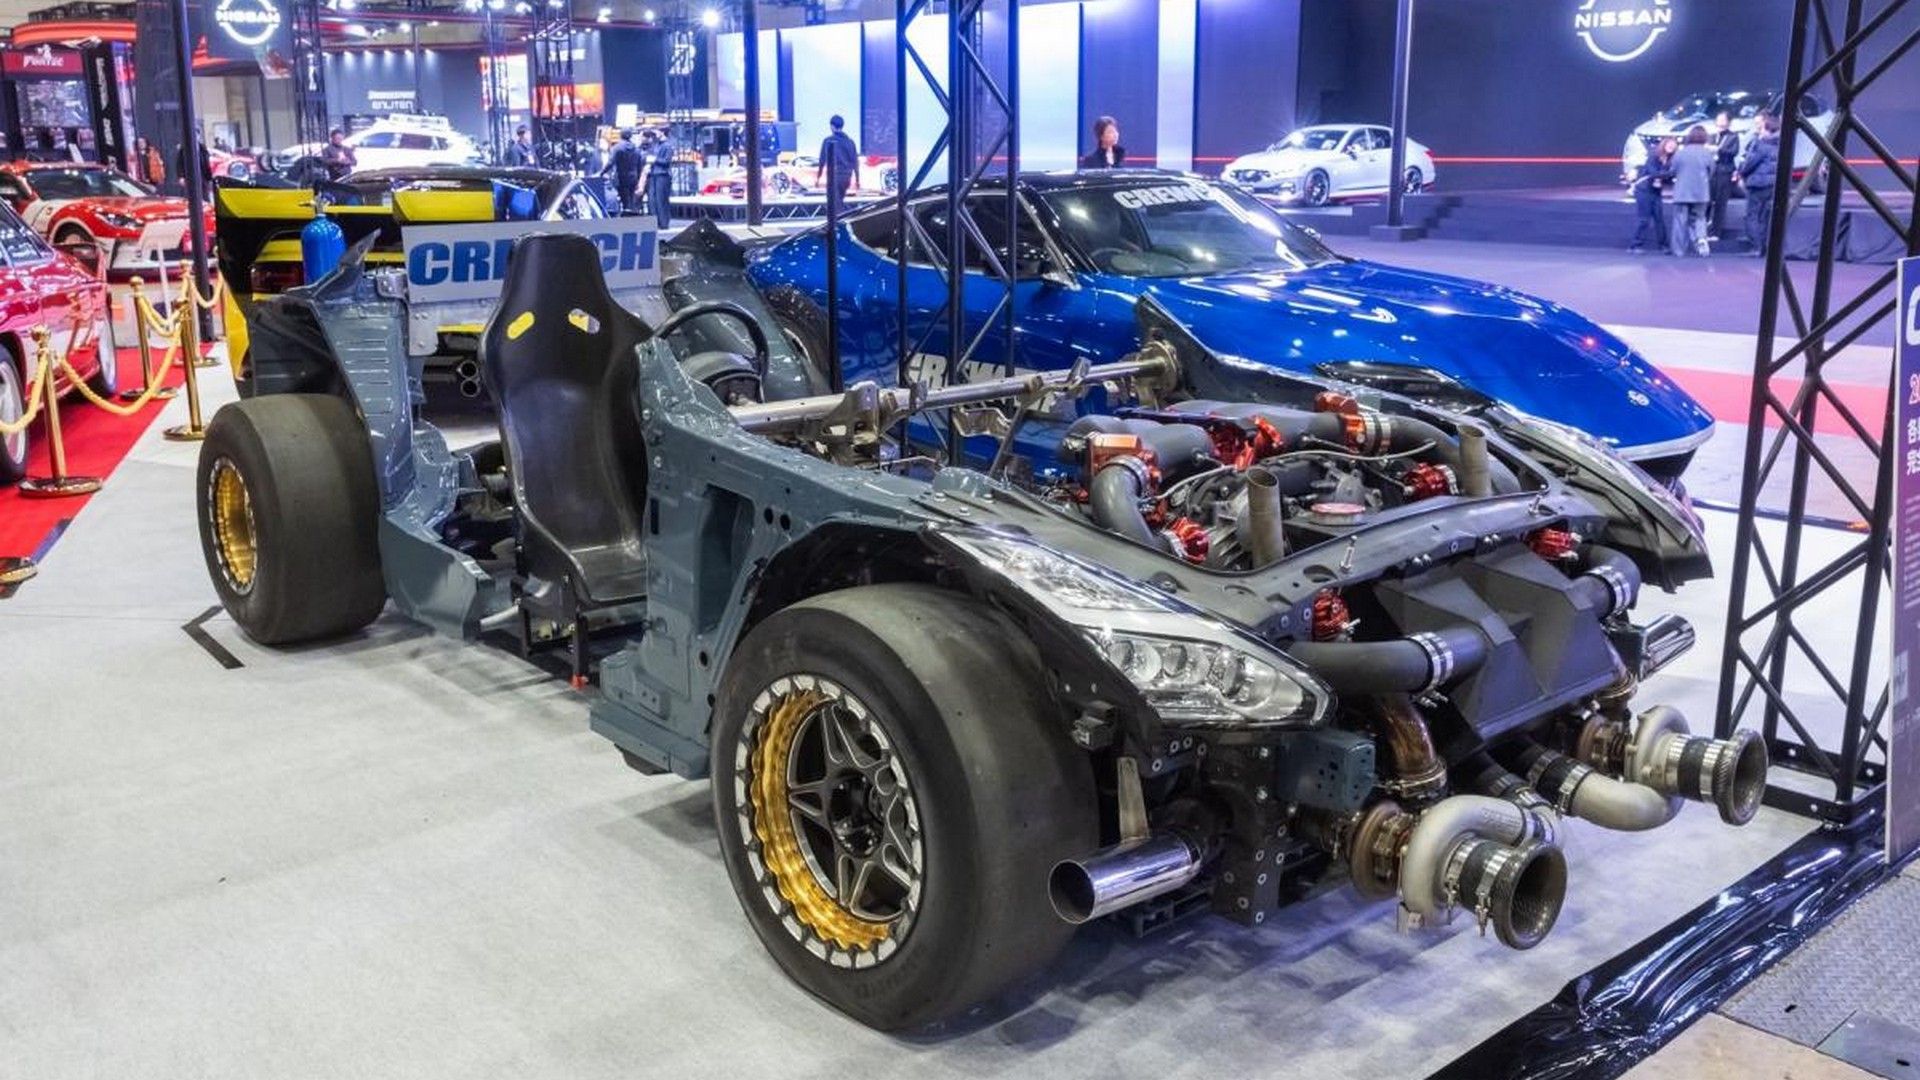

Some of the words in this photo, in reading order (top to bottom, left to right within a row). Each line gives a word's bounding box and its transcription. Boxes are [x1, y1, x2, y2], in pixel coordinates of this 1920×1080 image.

[215, 10, 281, 23] NISSAN
[1575, 8, 1671, 28] NISSAN
[408, 231, 656, 286] CRCH
